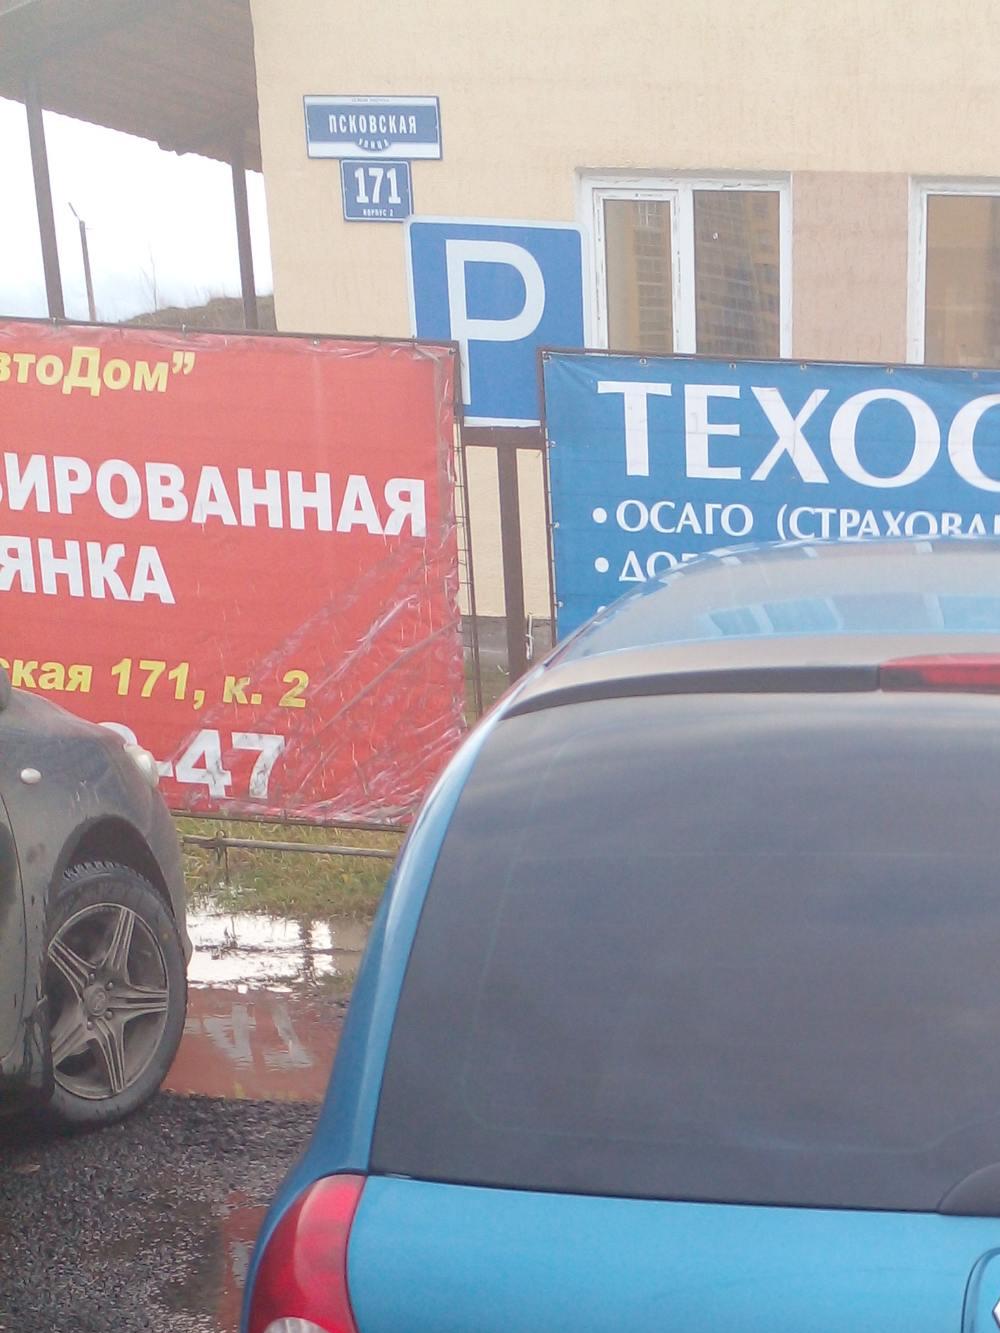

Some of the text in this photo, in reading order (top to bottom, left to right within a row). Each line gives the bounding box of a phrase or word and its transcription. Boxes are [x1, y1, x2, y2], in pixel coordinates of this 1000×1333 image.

[328, 113, 417, 134] ПСКОВСКАЯ
[354, 167, 401, 204] 171
[362, 208, 387, 217] КОРПУС
[0, 452, 427, 537] ИРОВАННАЯ
[616, 499, 754, 536] ОСАГО
[0, 657, 309, 710] кая 171, к. 2
[99, 722, 286, 800] -47
